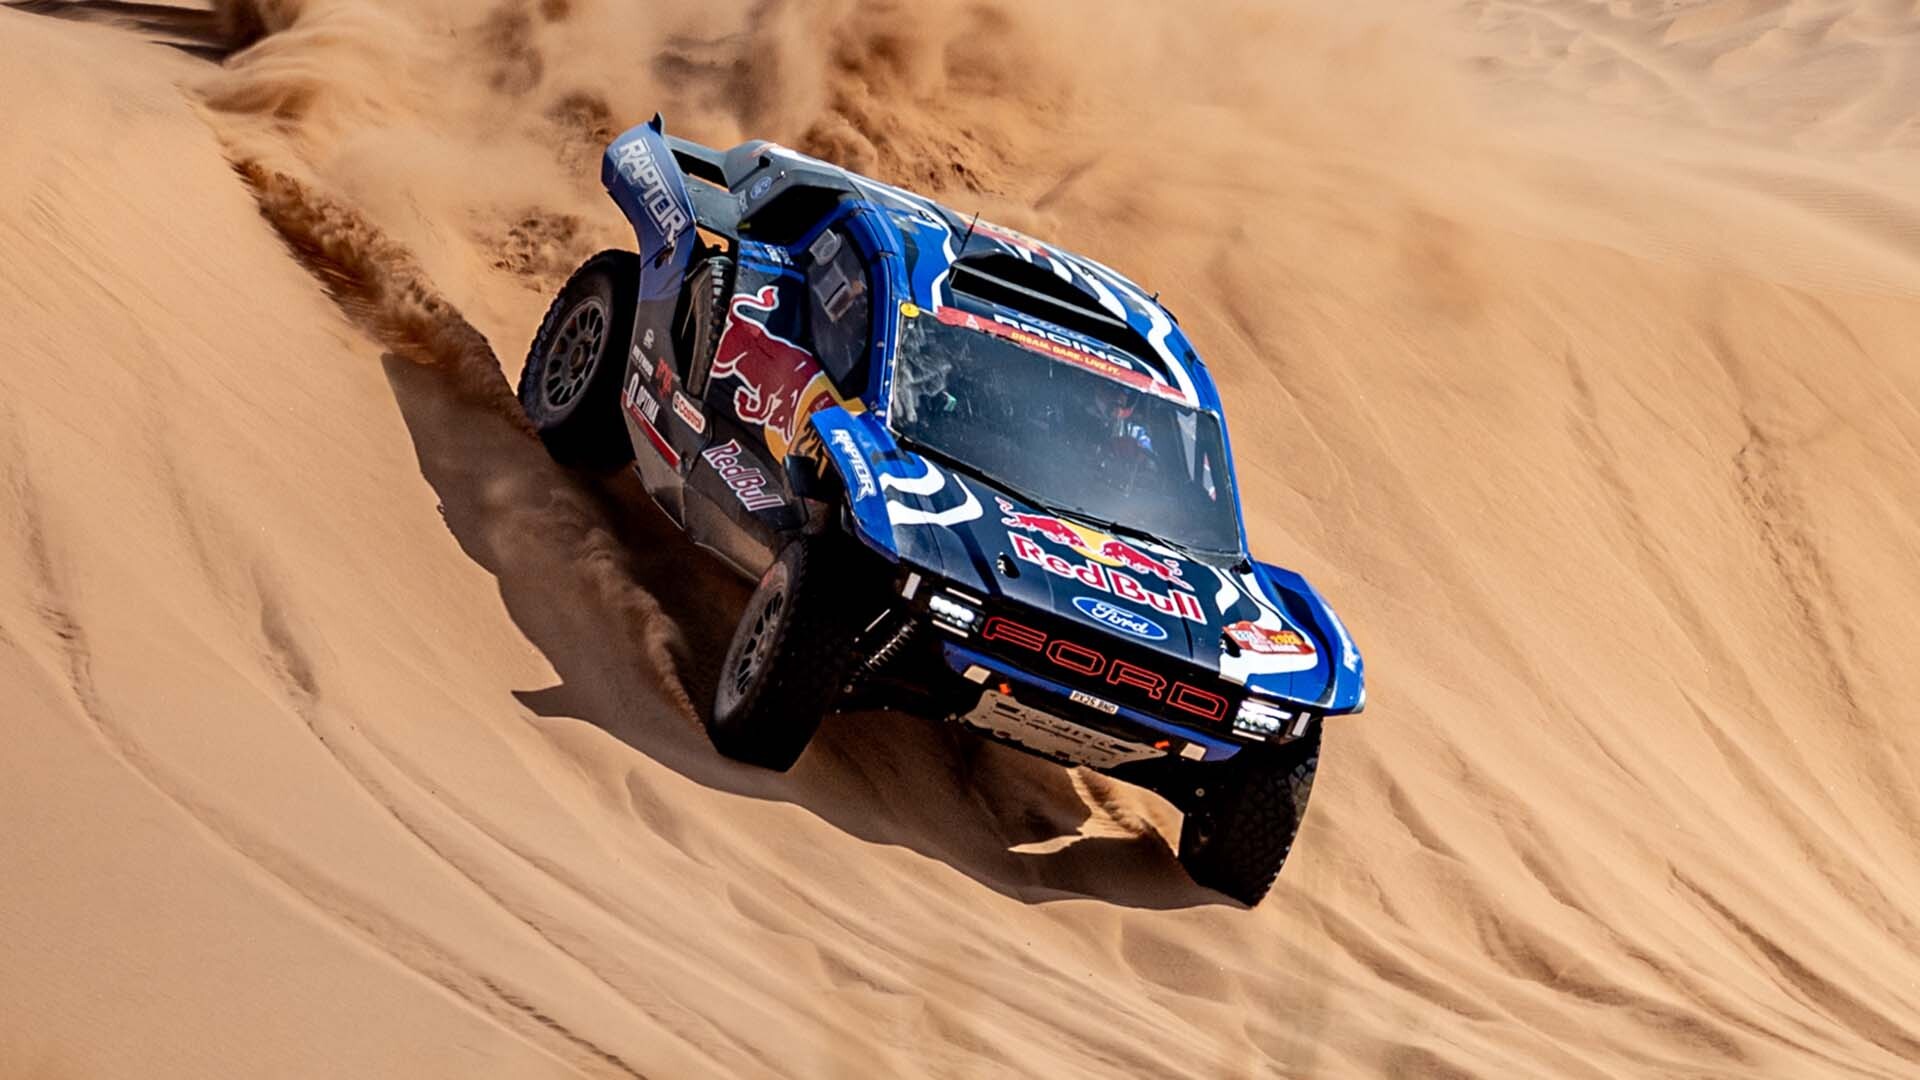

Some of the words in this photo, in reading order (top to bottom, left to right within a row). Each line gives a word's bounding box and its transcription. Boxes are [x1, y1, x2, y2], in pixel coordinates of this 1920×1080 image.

[614, 136, 689, 247] RAPTOR
[993, 313, 1133, 370] RACING
[1010, 331, 1050, 351] DREAM.
[1052, 345, 1084, 362] DARE.
[830, 428, 877, 502] RAPTOR
[1008, 531, 1110, 593] Red
[1107, 568, 1208, 625] Bull
[1091, 600, 1150, 635] Ford
[984, 616, 1229, 721] FORD
